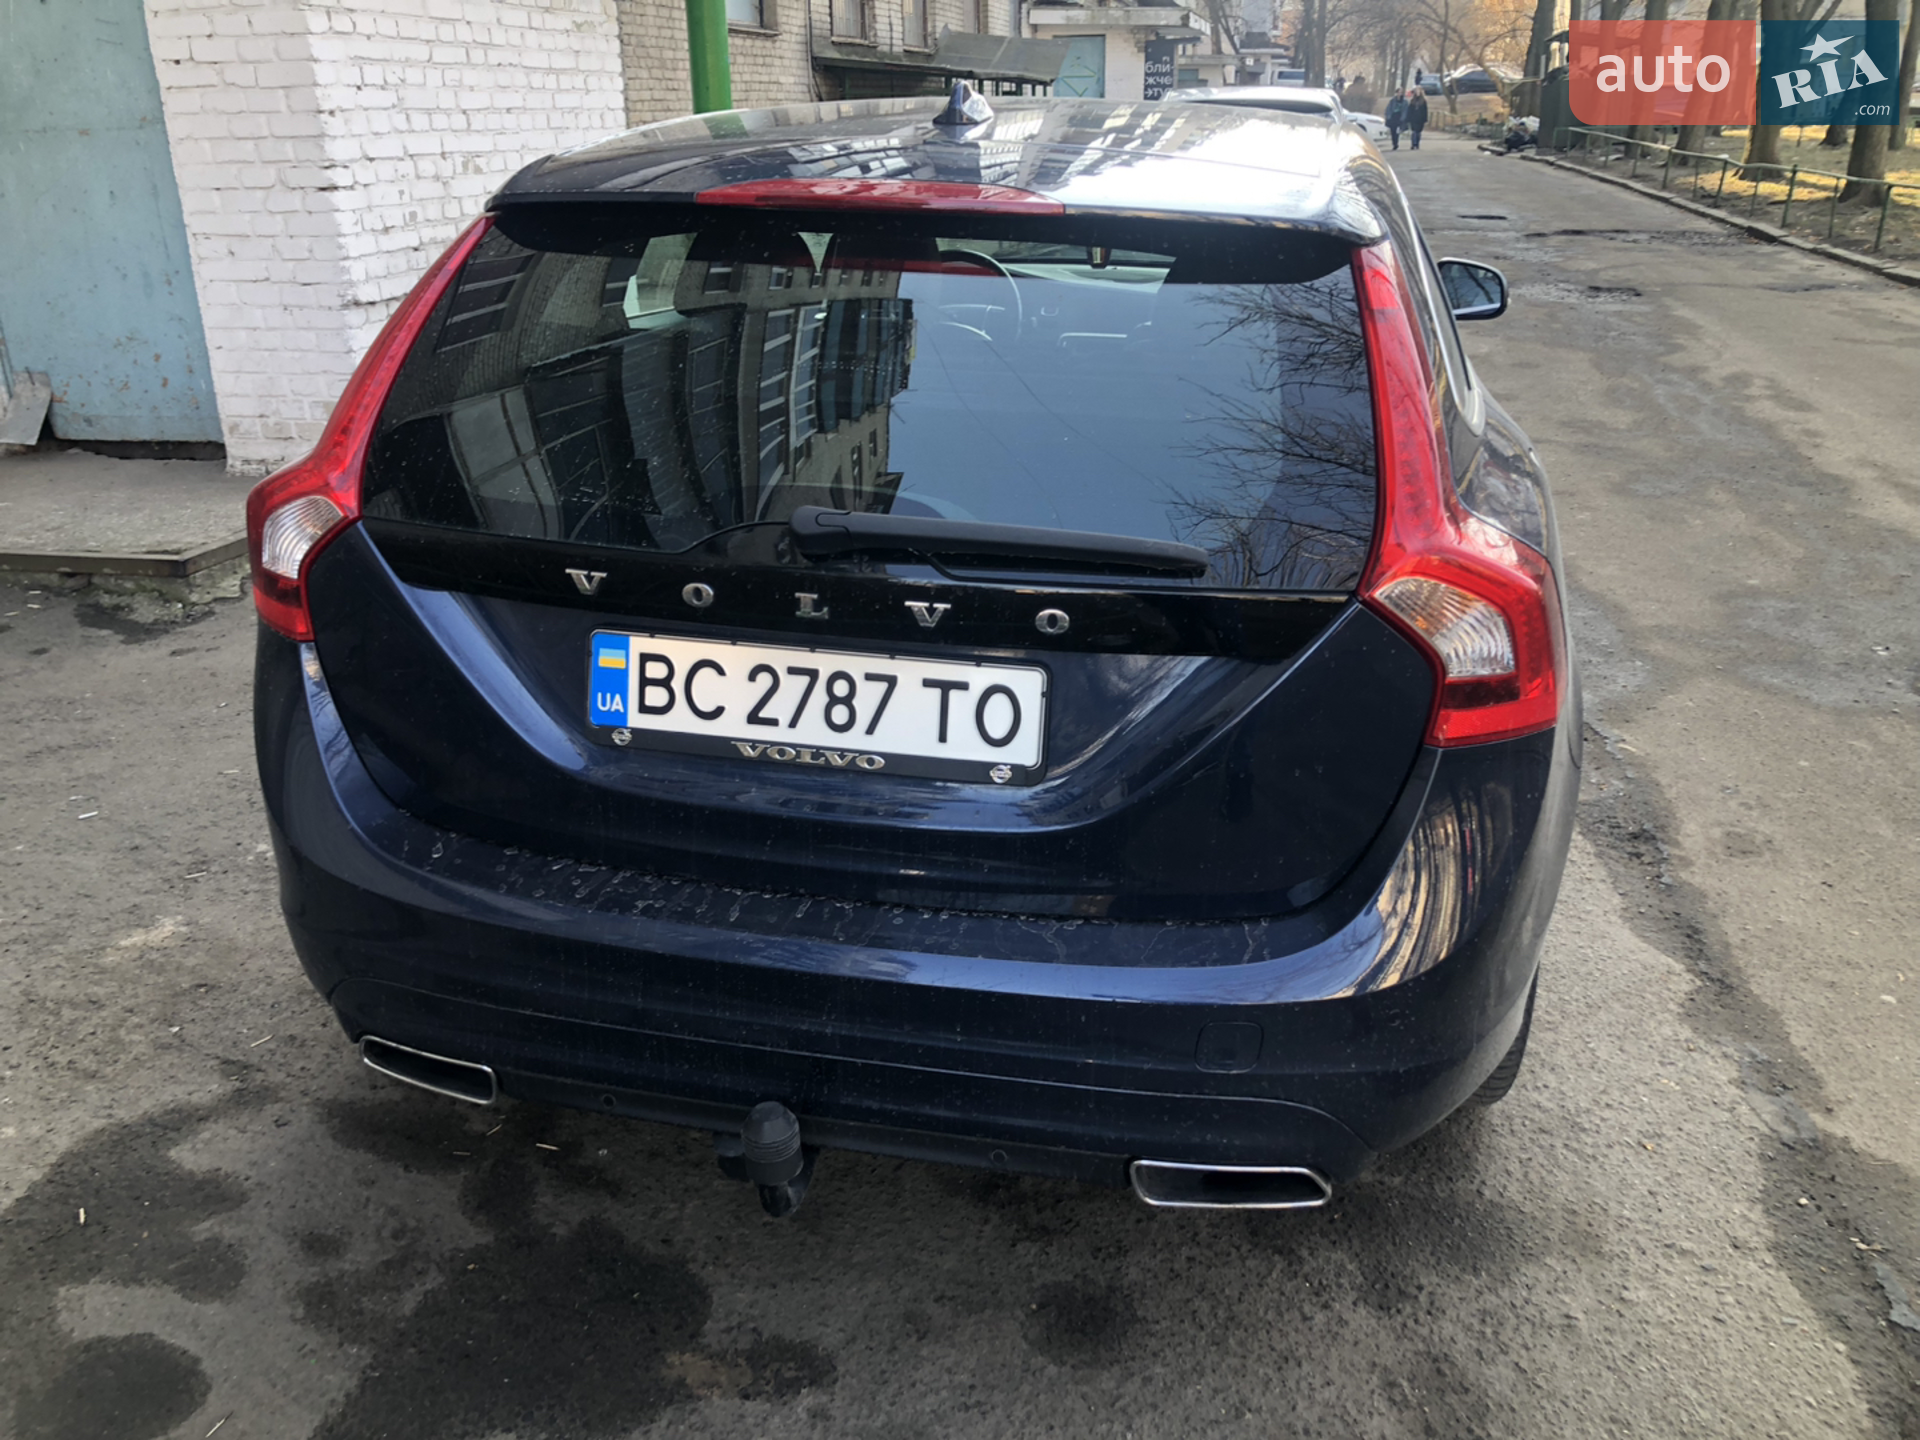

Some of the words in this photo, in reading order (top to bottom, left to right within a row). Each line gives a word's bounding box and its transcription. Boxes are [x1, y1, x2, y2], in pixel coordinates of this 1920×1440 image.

[565, 568, 1071, 634] VOLVO
[597, 691, 624, 713] UA
[637, 652, 727, 721] BC
[746, 663, 898, 735] 2787
[922, 677, 1022, 748] TO
[731, 741, 886, 770] VOLVO
